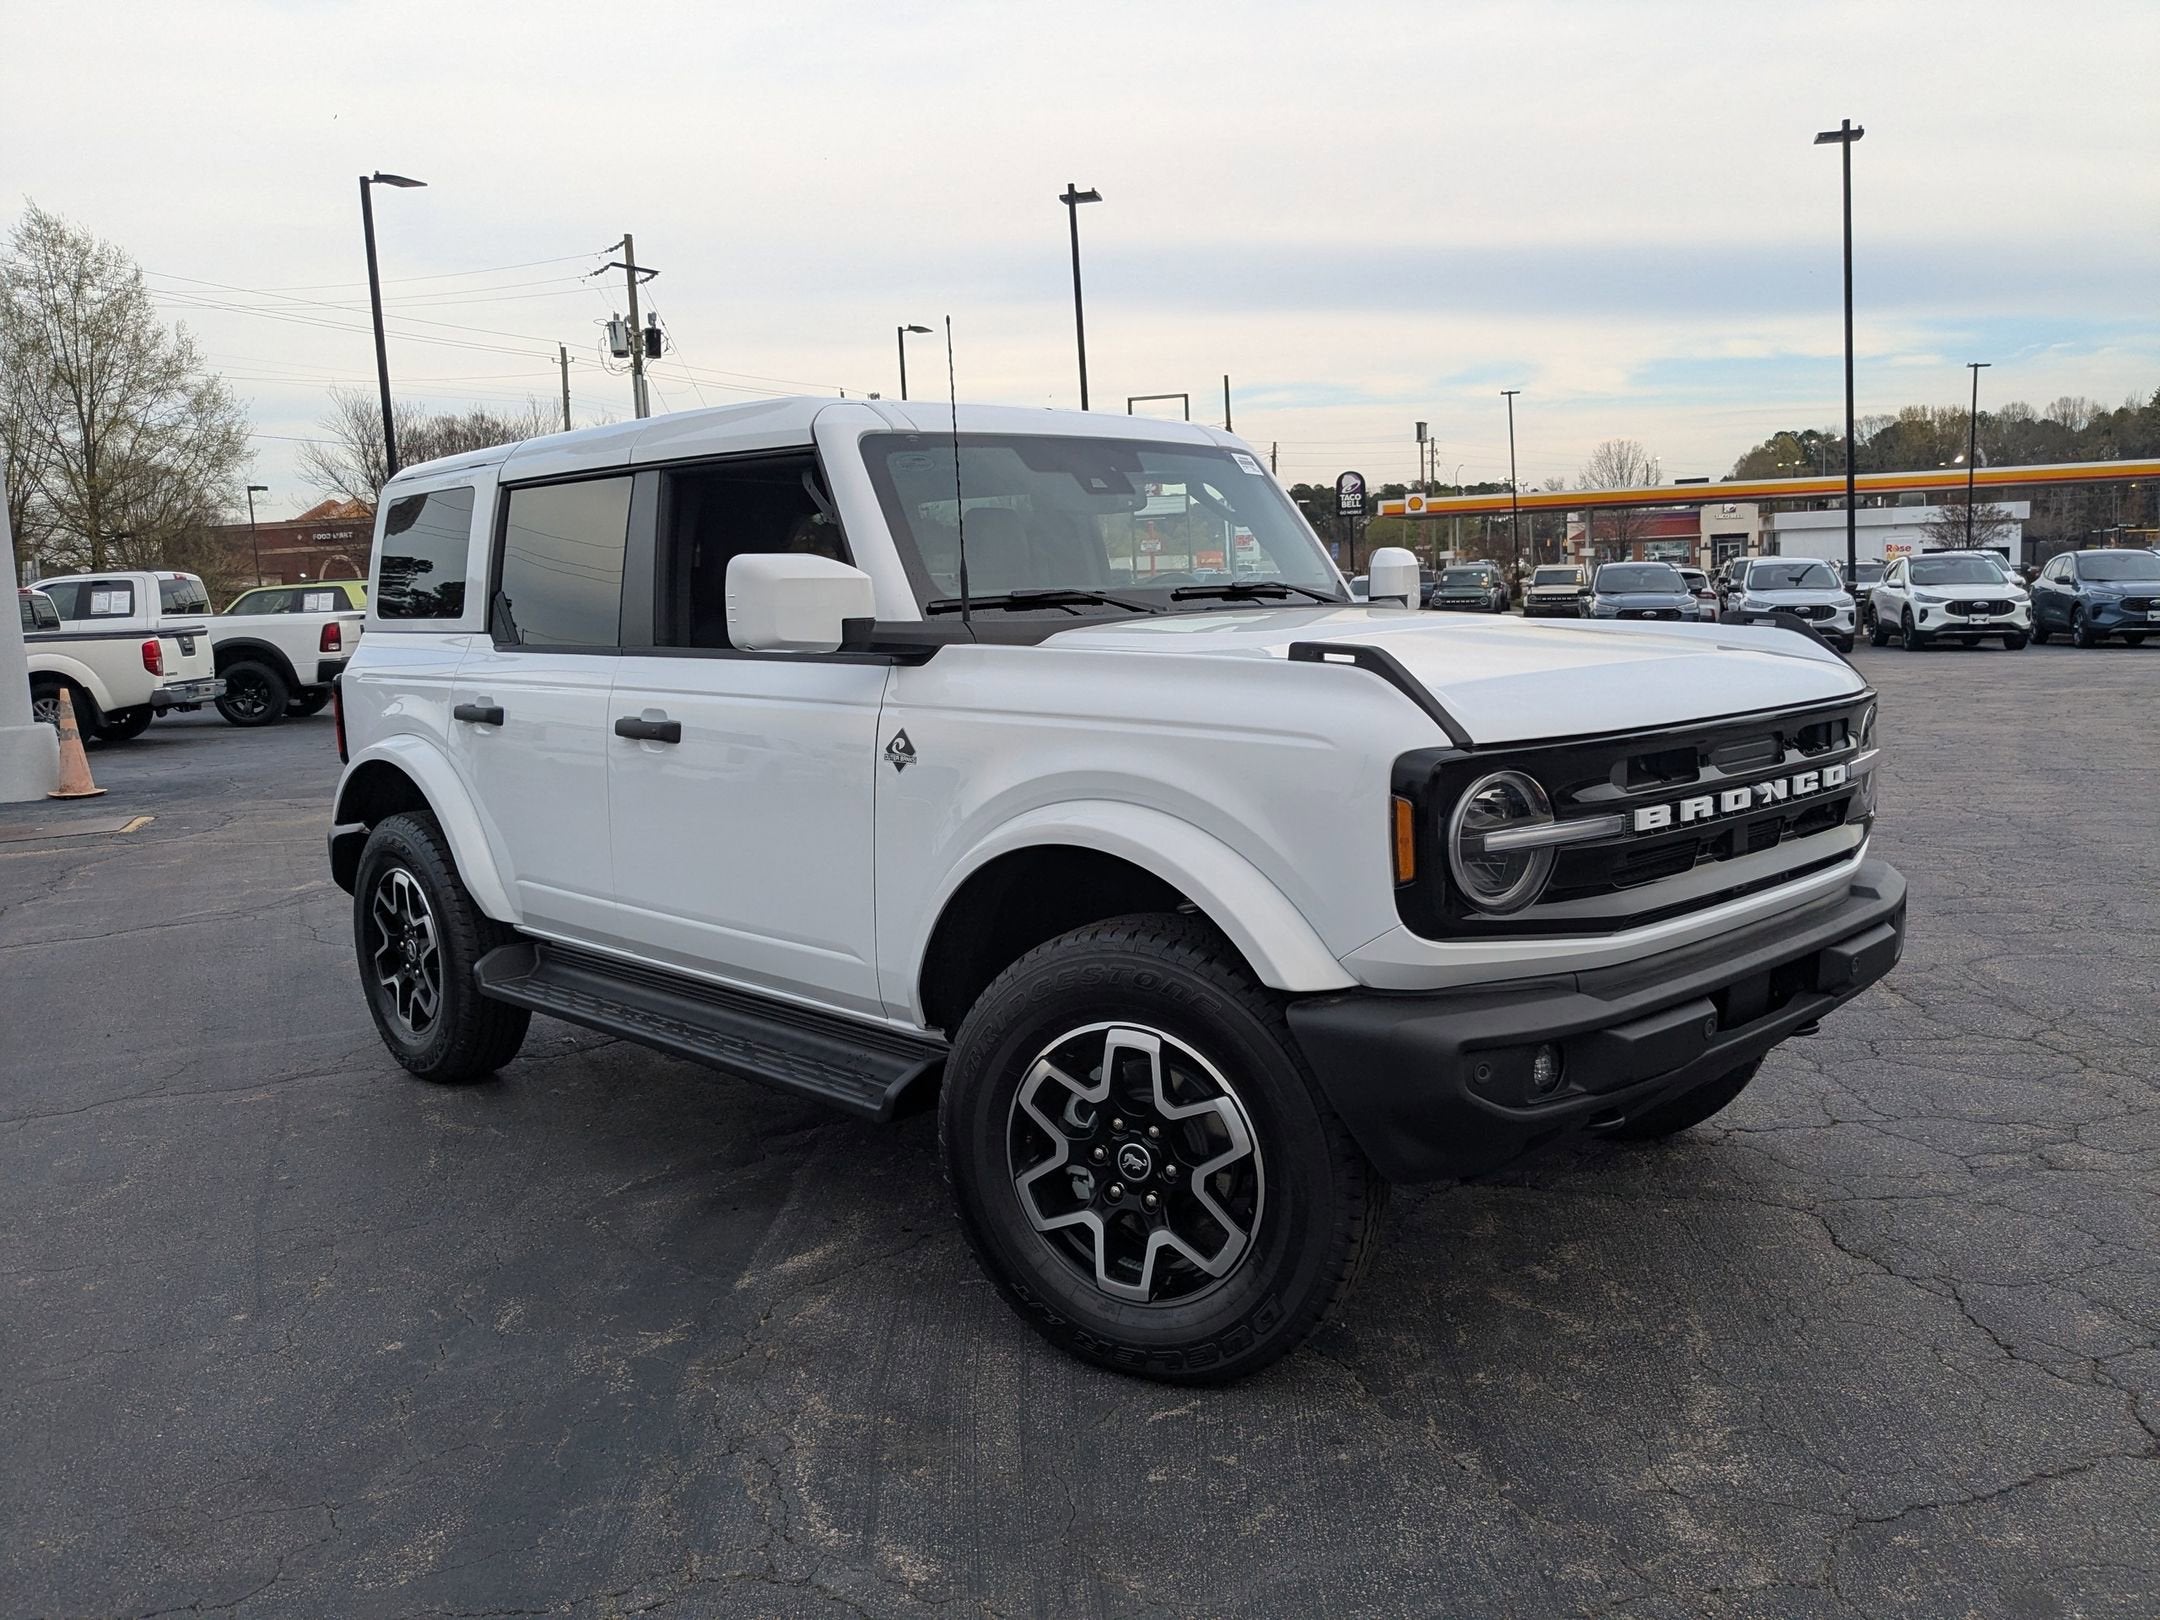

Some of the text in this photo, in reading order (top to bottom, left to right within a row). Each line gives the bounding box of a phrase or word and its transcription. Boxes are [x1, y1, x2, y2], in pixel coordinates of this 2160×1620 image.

[1341, 500, 1361, 508] BELL
[1886, 544, 1911, 552] Rose
[1634, 763, 1846, 832] BRONCO
[965, 964, 1222, 1077] BRIDGESTONE
